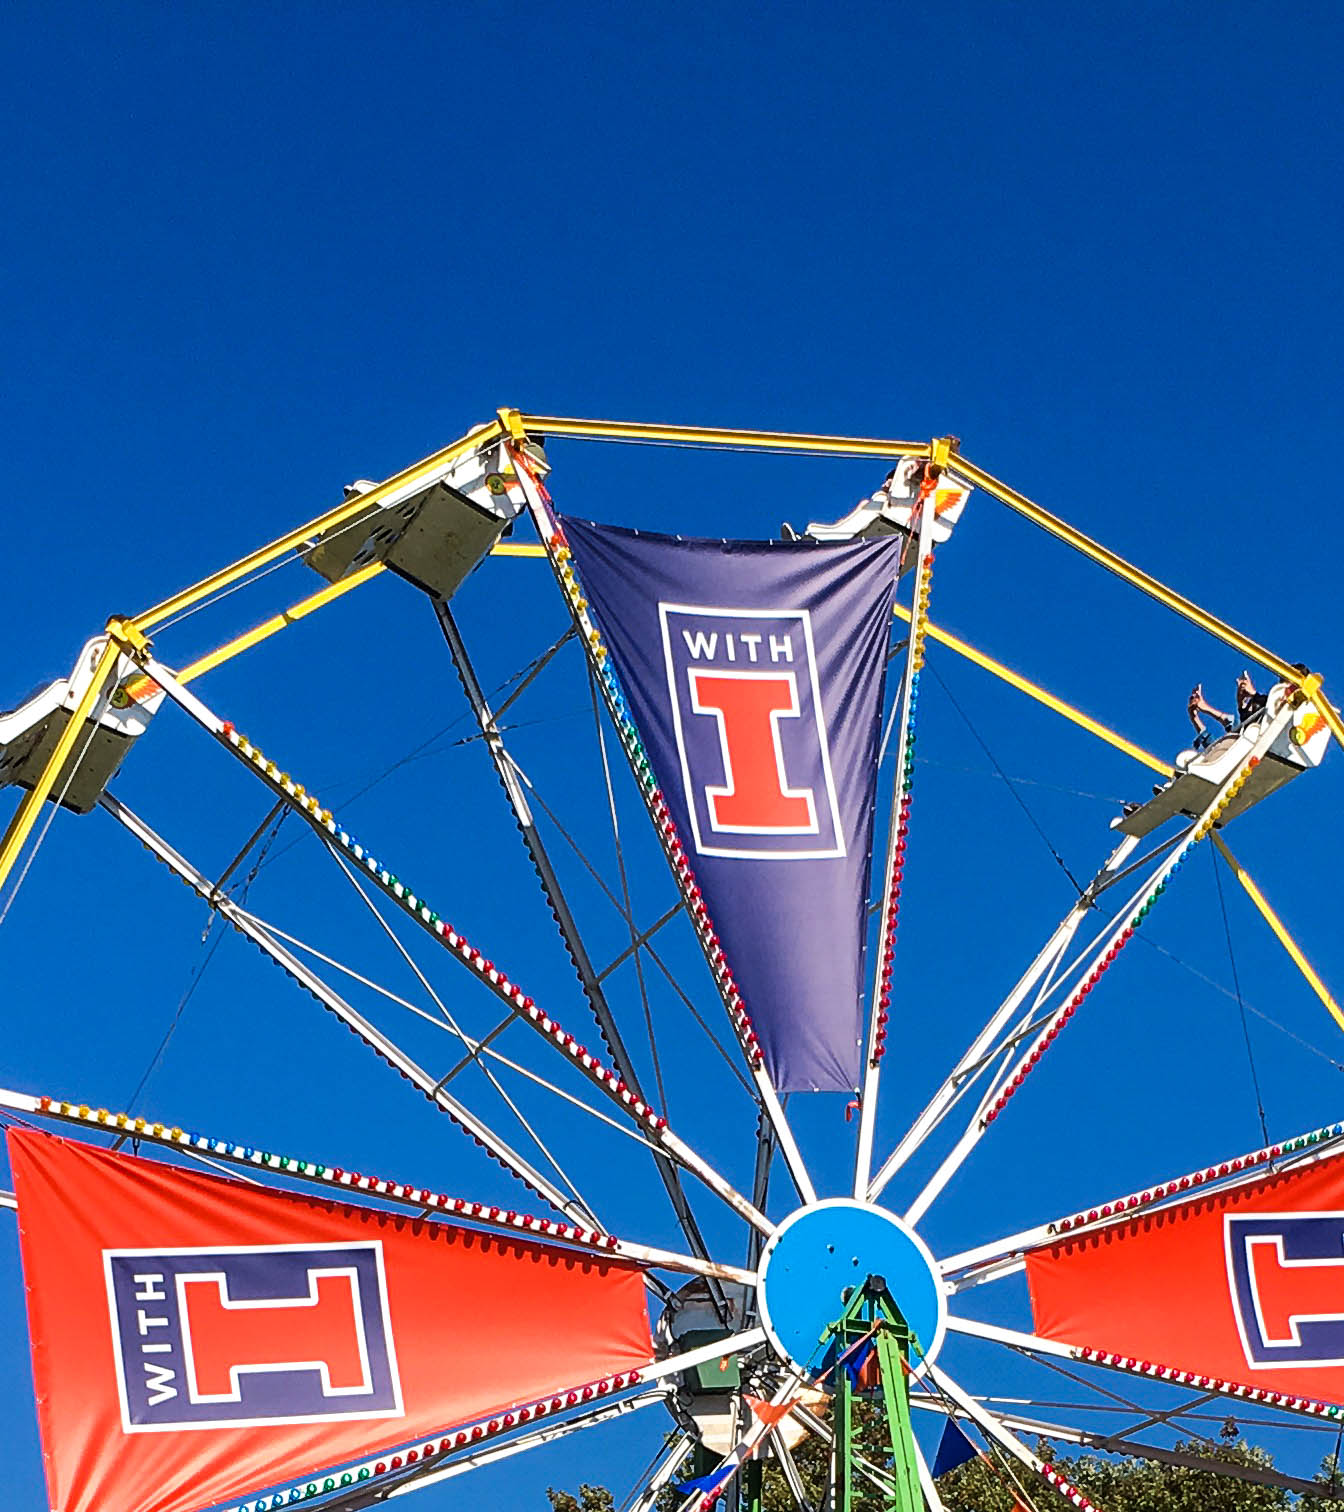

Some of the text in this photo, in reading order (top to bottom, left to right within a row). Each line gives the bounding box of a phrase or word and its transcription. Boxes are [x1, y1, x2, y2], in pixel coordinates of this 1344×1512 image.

[683, 630, 794, 662] WITH
[688, 667, 819, 834] I
[134, 1273, 178, 1406] WITH
[174, 1267, 375, 1405] I
